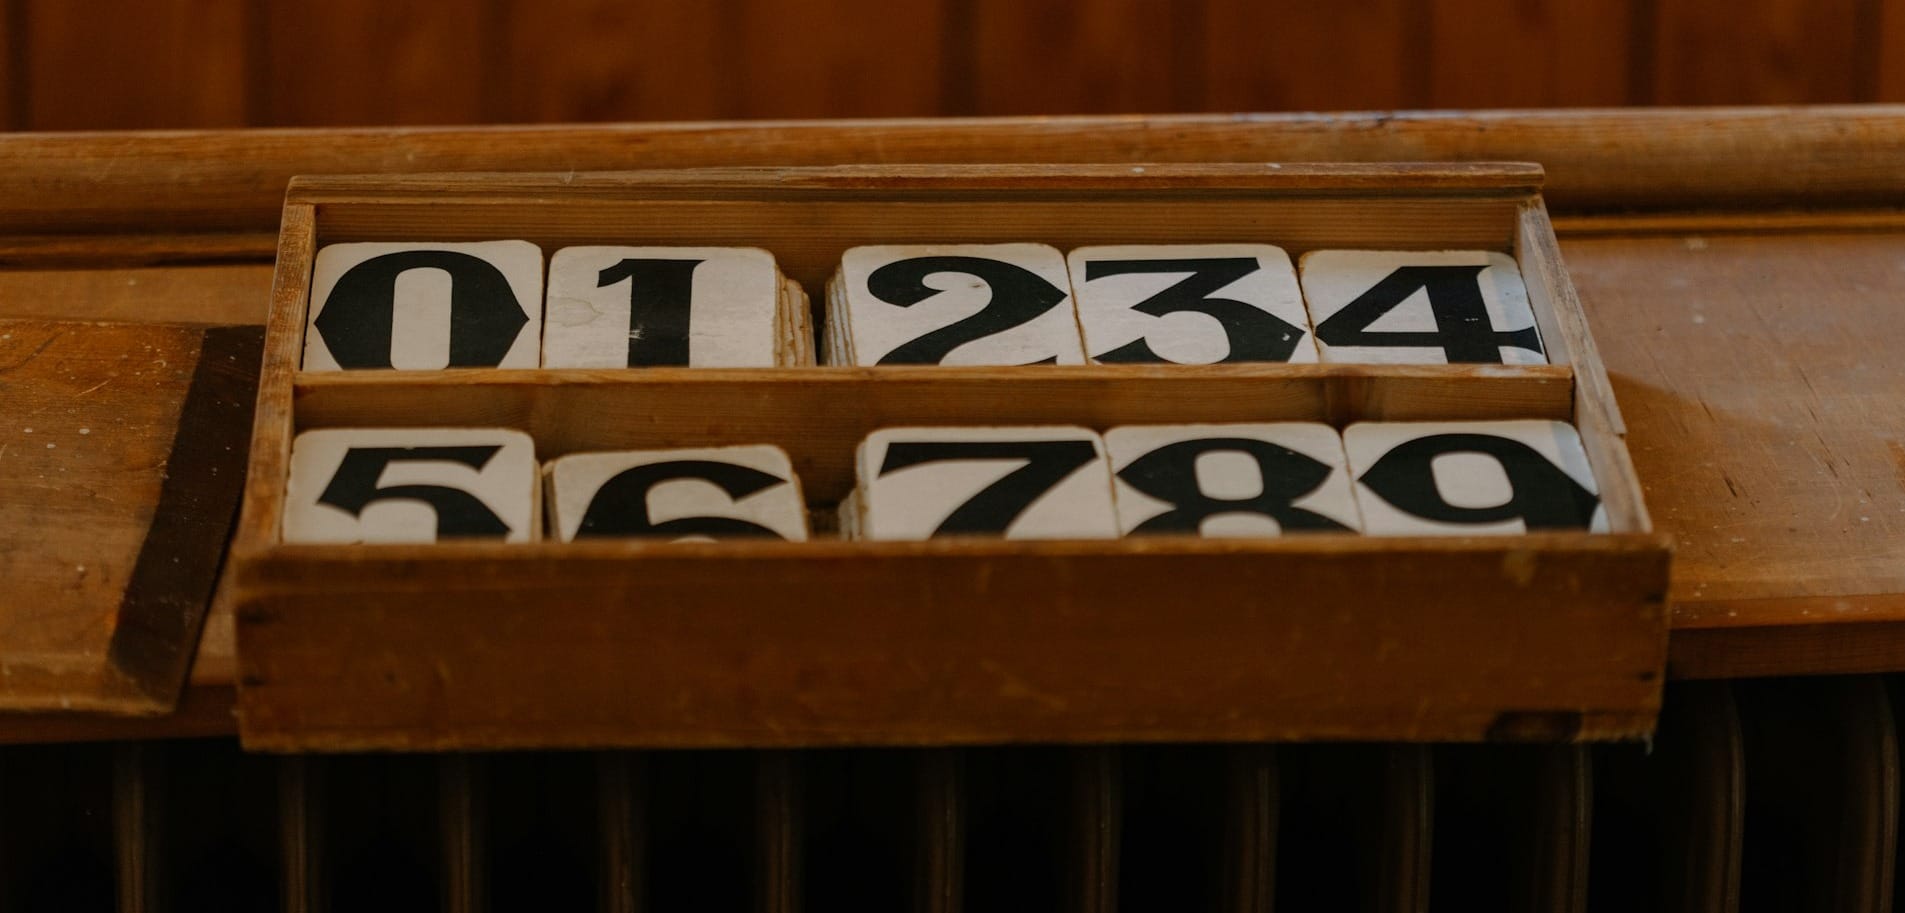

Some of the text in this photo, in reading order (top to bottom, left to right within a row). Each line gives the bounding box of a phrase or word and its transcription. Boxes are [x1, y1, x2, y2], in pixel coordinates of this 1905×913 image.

[314, 251, 1543, 370] 0 1 2 3 4
[317, 433, 1600, 541] 5 6 7 8 9
